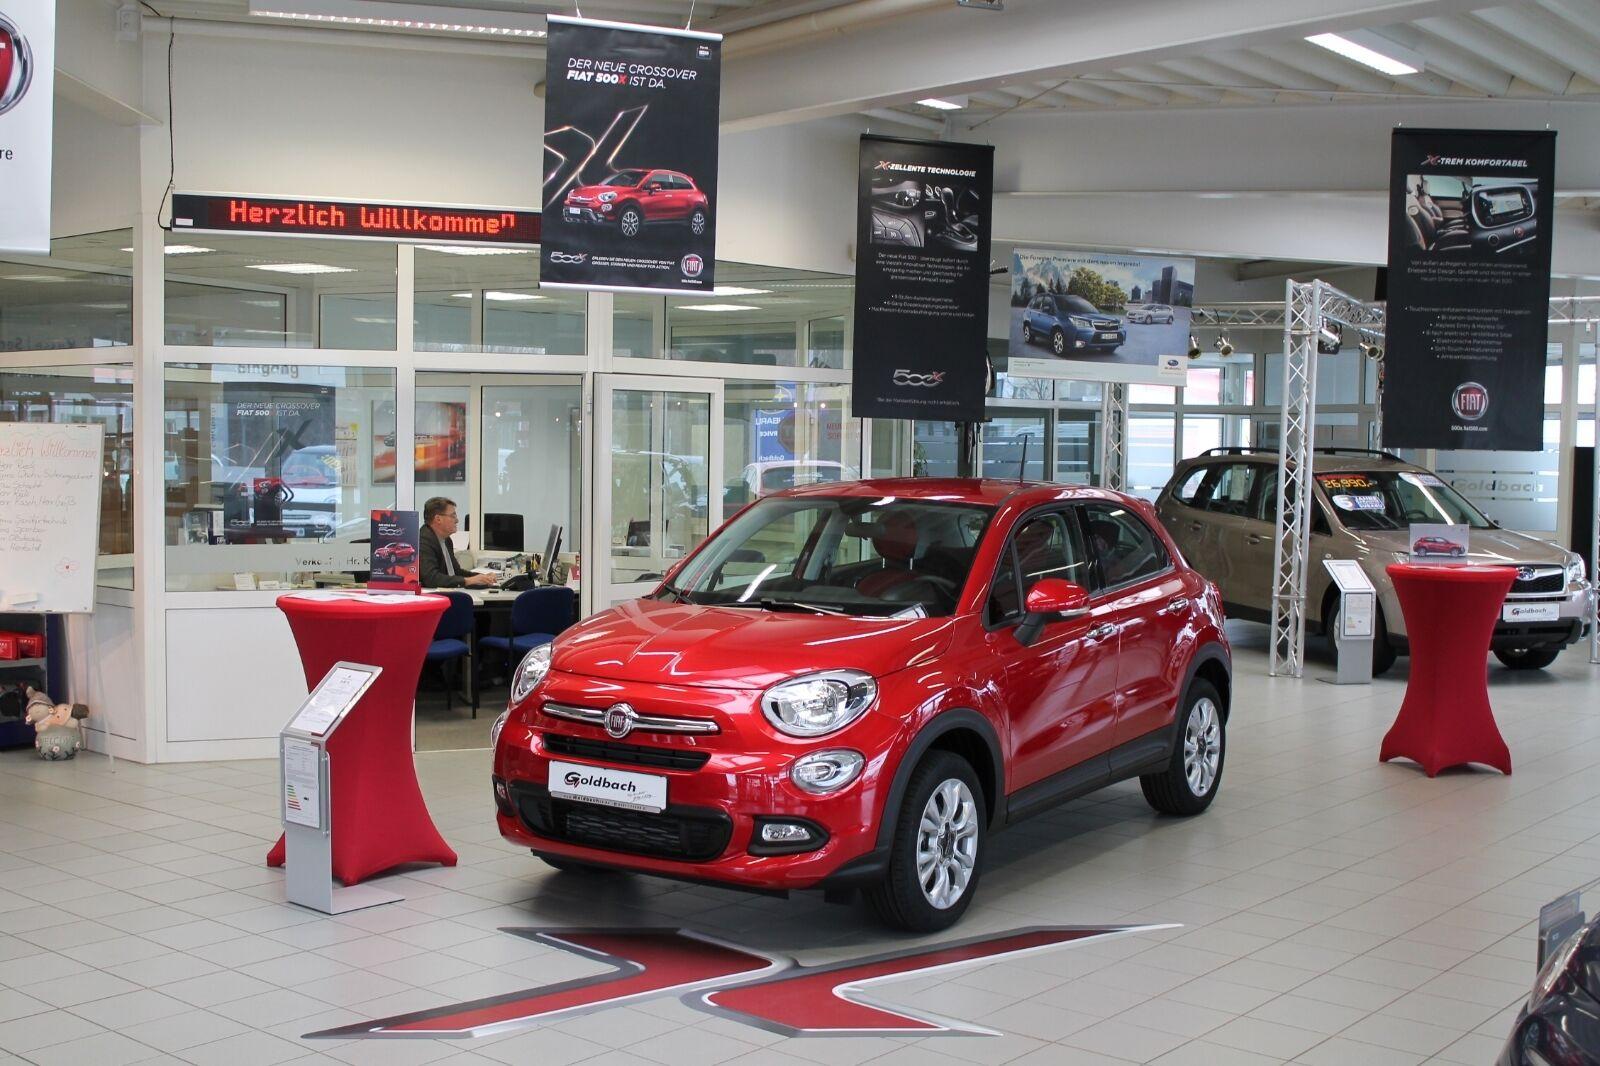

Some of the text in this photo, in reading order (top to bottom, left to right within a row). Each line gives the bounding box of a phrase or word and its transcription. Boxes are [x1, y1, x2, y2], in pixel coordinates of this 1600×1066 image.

[567, 58, 697, 80] DER NEUE CROSSOVER
[566, 70, 666, 89] FIAT 500X IST DA.
[1465, 158, 1528, 168] KOMFORTABEL
[927, 167, 976, 177] TECHNOLOGIE
[230, 200, 515, 233] Herzlich Willkommen
[686, 260, 699, 271] FIAT
[1461, 393, 1481, 410] FIAT
[236, 409, 254, 417] FIAT
[611, 714, 624, 728] FIAT
[564, 771, 637, 793] Goldbach
